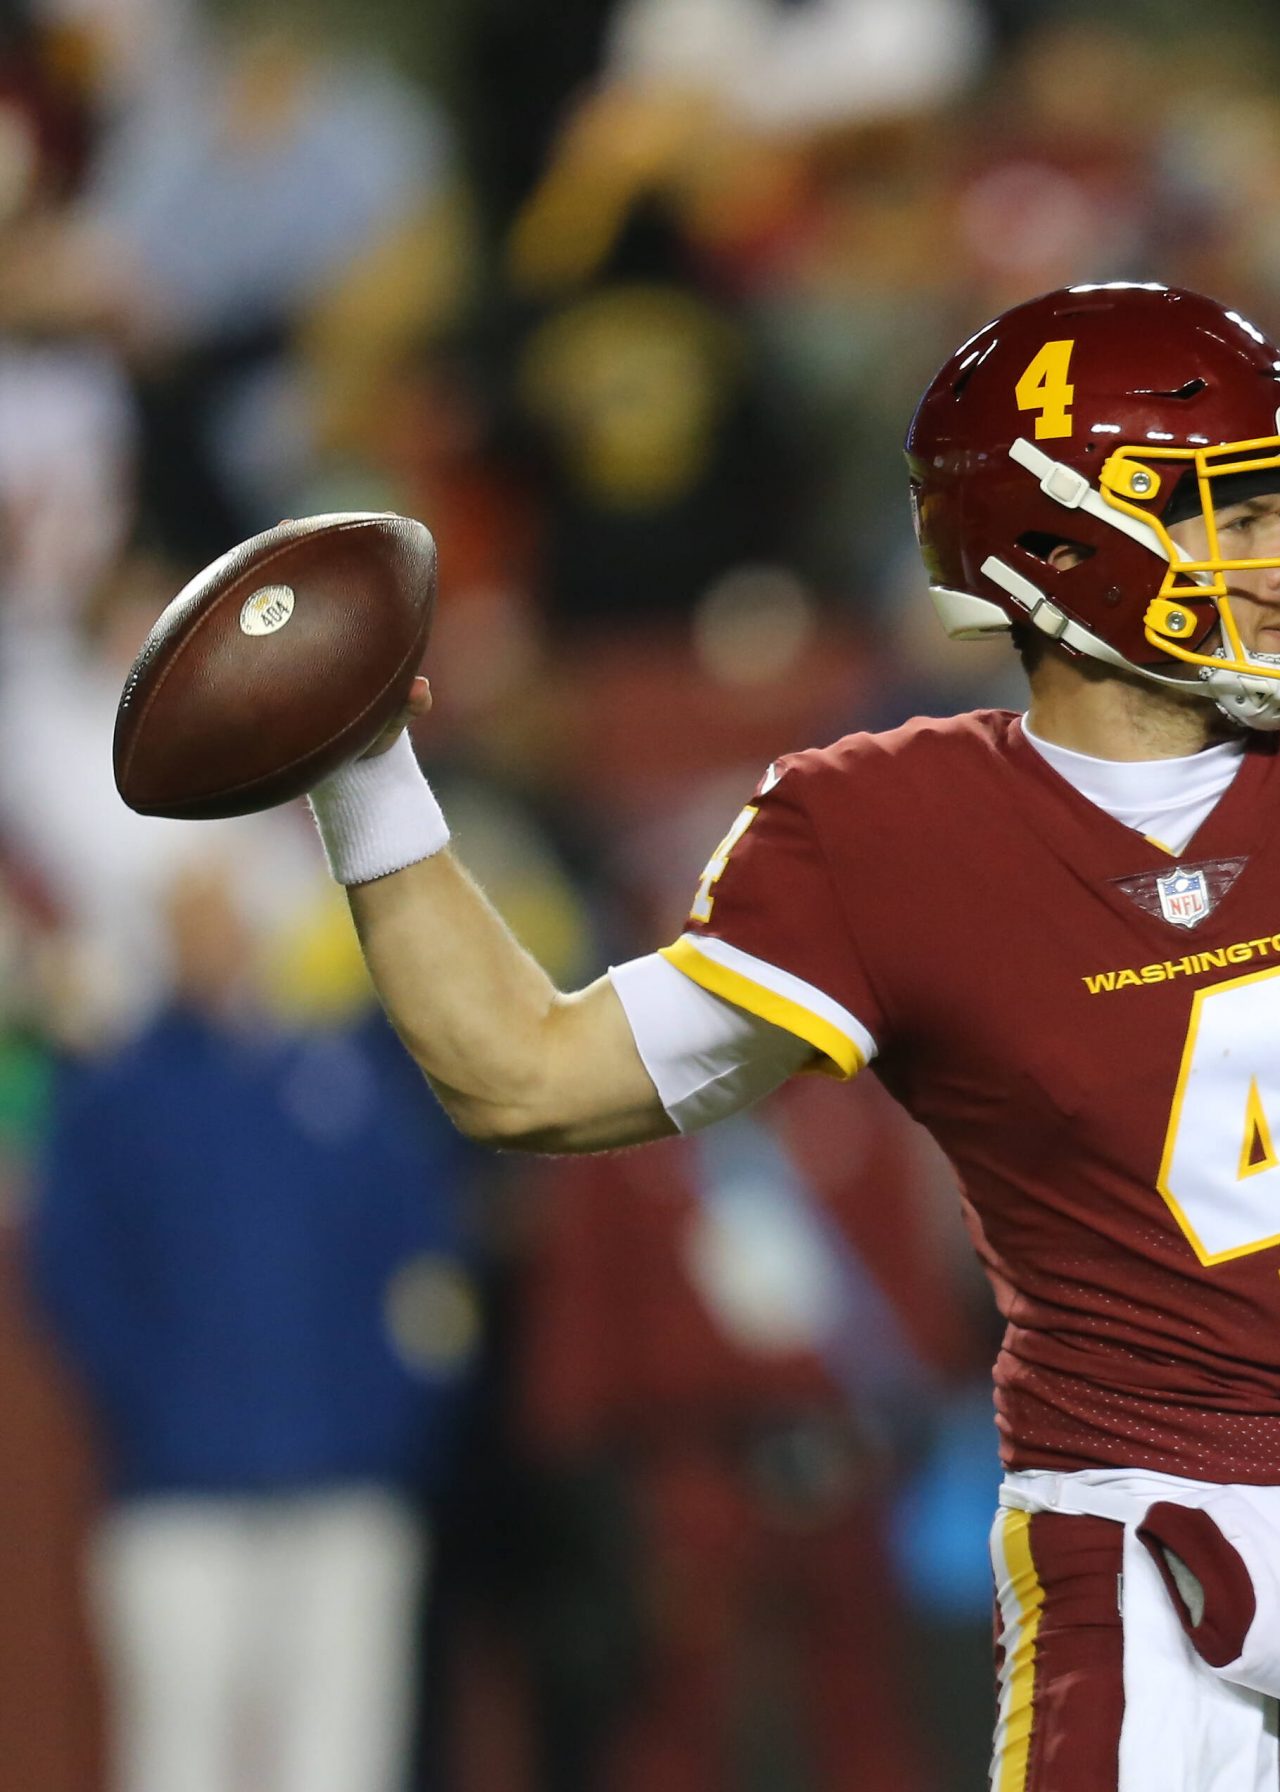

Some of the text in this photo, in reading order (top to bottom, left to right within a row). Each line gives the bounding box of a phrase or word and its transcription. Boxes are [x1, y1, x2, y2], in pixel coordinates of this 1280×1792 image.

[1015, 339, 1075, 440] 4
[261, 601, 289, 627] 404
[1167, 893, 1203, 916] NFL
